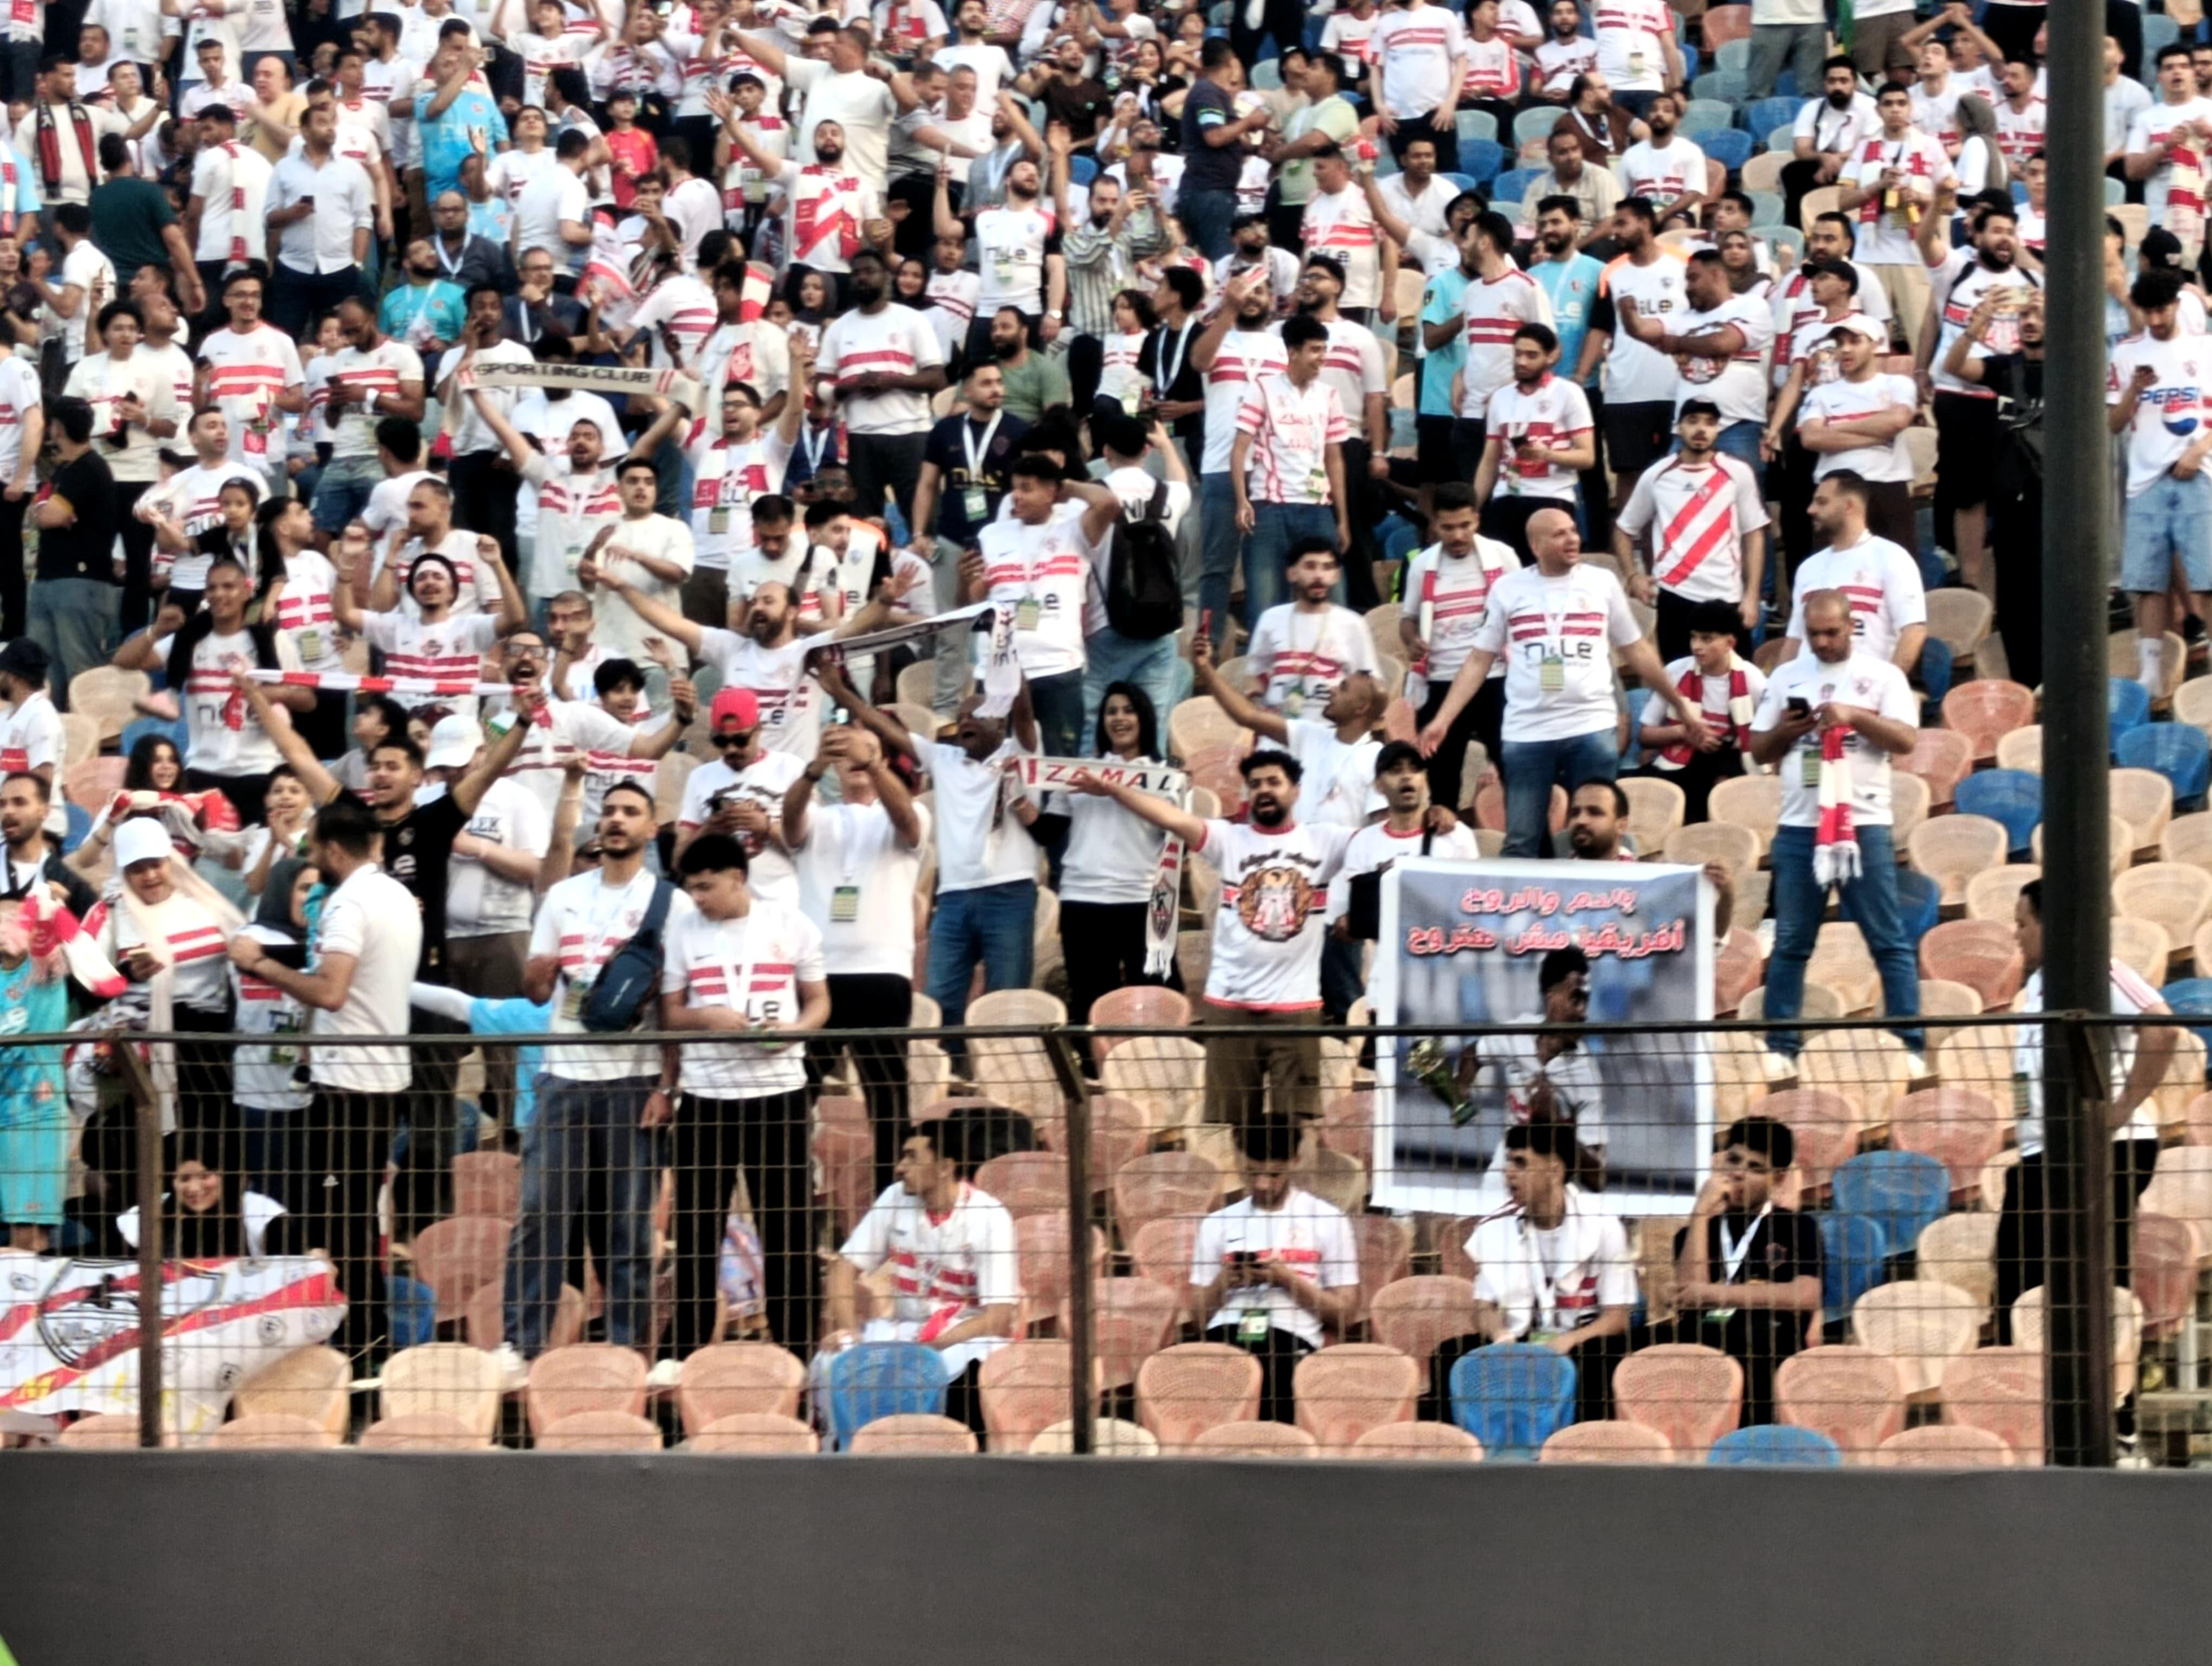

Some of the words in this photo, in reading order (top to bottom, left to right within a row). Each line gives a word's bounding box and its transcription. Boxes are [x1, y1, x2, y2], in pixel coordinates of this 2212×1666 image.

[473, 362, 588, 379] SPORTING
[593, 369, 650, 383] CLUB
[1045, 763, 1181, 792] ZAMAL
[1460, 885, 1560, 916] والروح
[1564, 887, 1638, 915] بالدم
[1405, 921, 1497, 956] هتروح
[1504, 922, 1570, 955] مش
